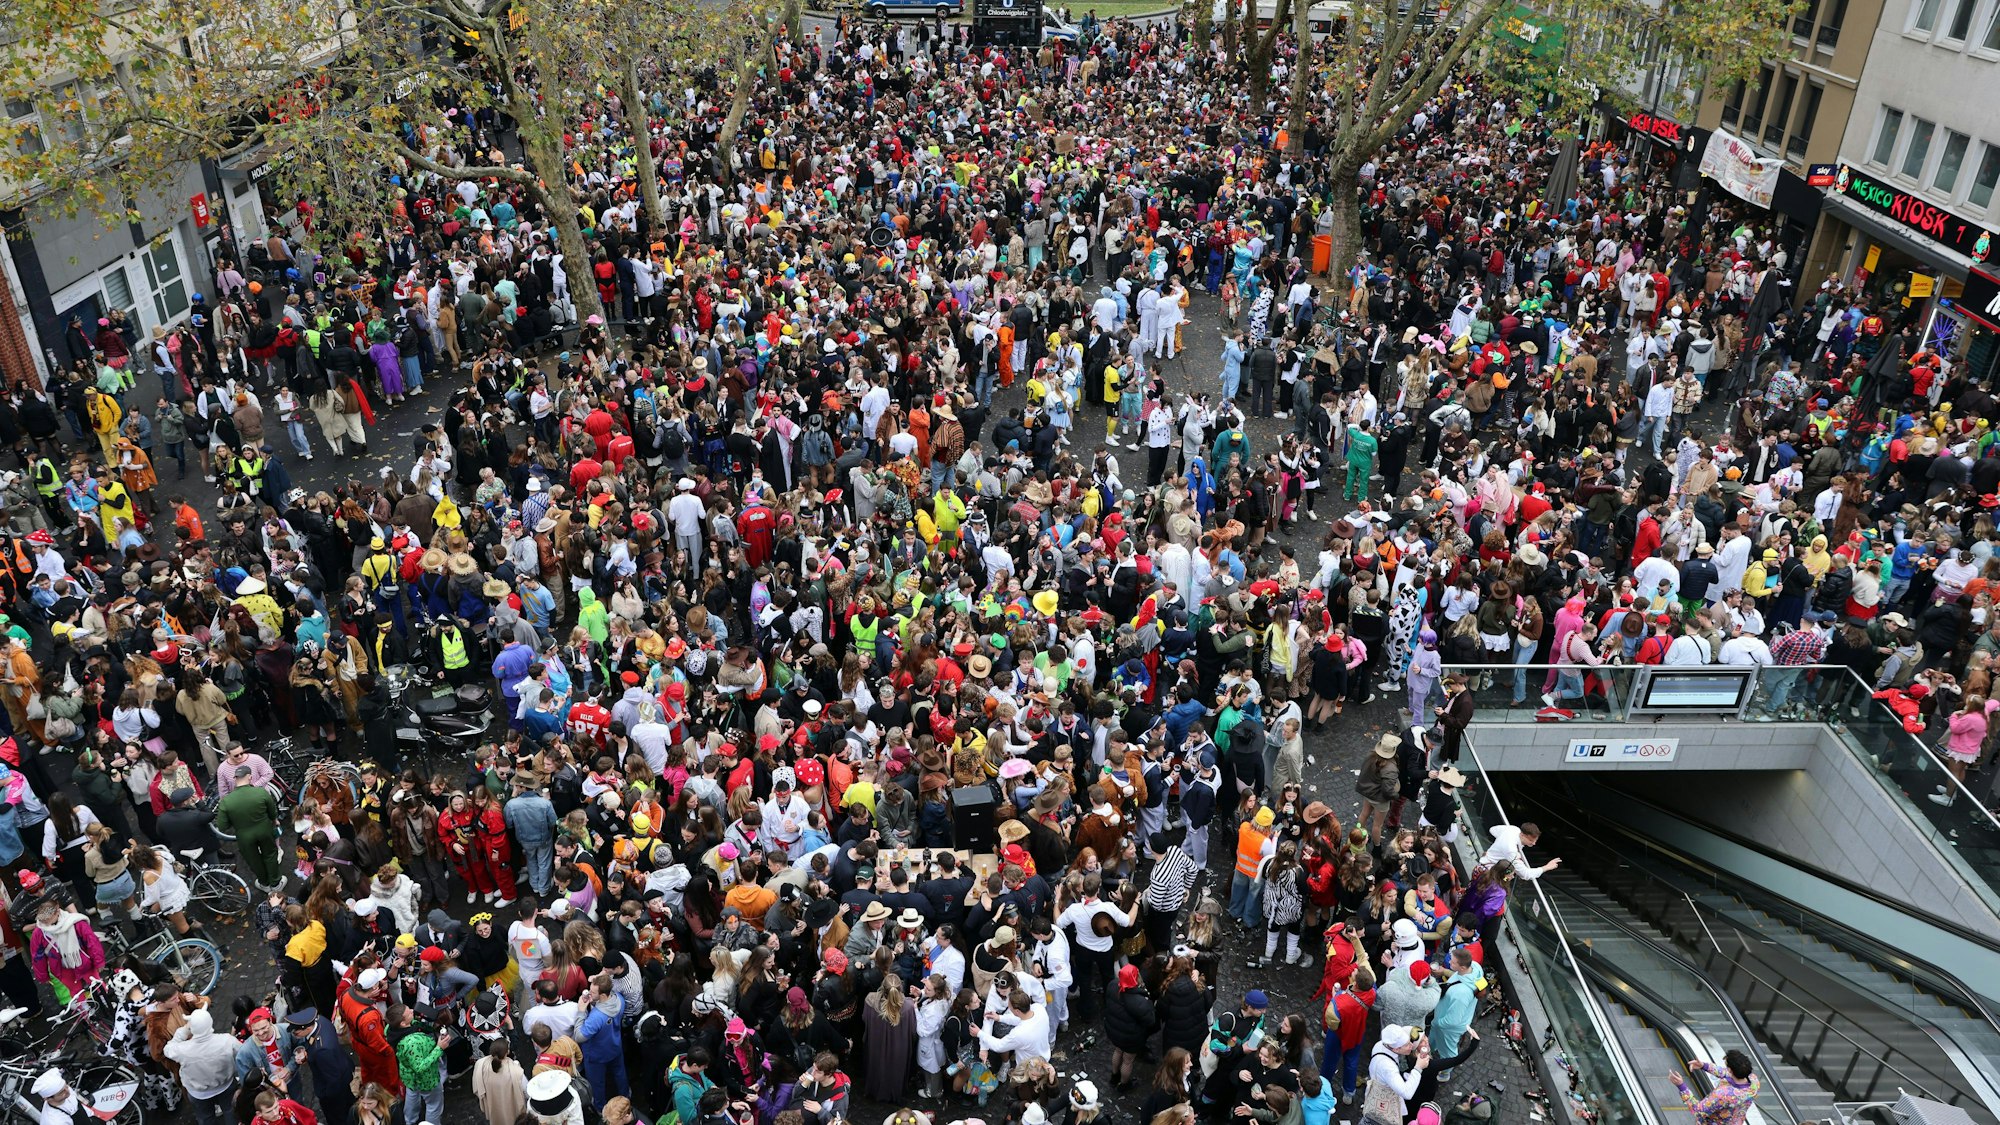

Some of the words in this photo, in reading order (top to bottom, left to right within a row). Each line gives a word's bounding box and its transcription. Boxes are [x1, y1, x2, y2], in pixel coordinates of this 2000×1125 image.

[1629, 113, 1681, 141] KIOSK
[1816, 166, 1831, 176] sky
[1812, 178, 1829, 186] sport
[421, 205, 432, 215] 12
[1850, 177, 1893, 208] MEXICO
[1890, 194, 1950, 240] KIOSK
[574, 720, 600, 739] 87
[1575, 745, 1590, 756] U
[1592, 746, 1605, 756] 17
[100, 1093, 116, 1103] KVB
